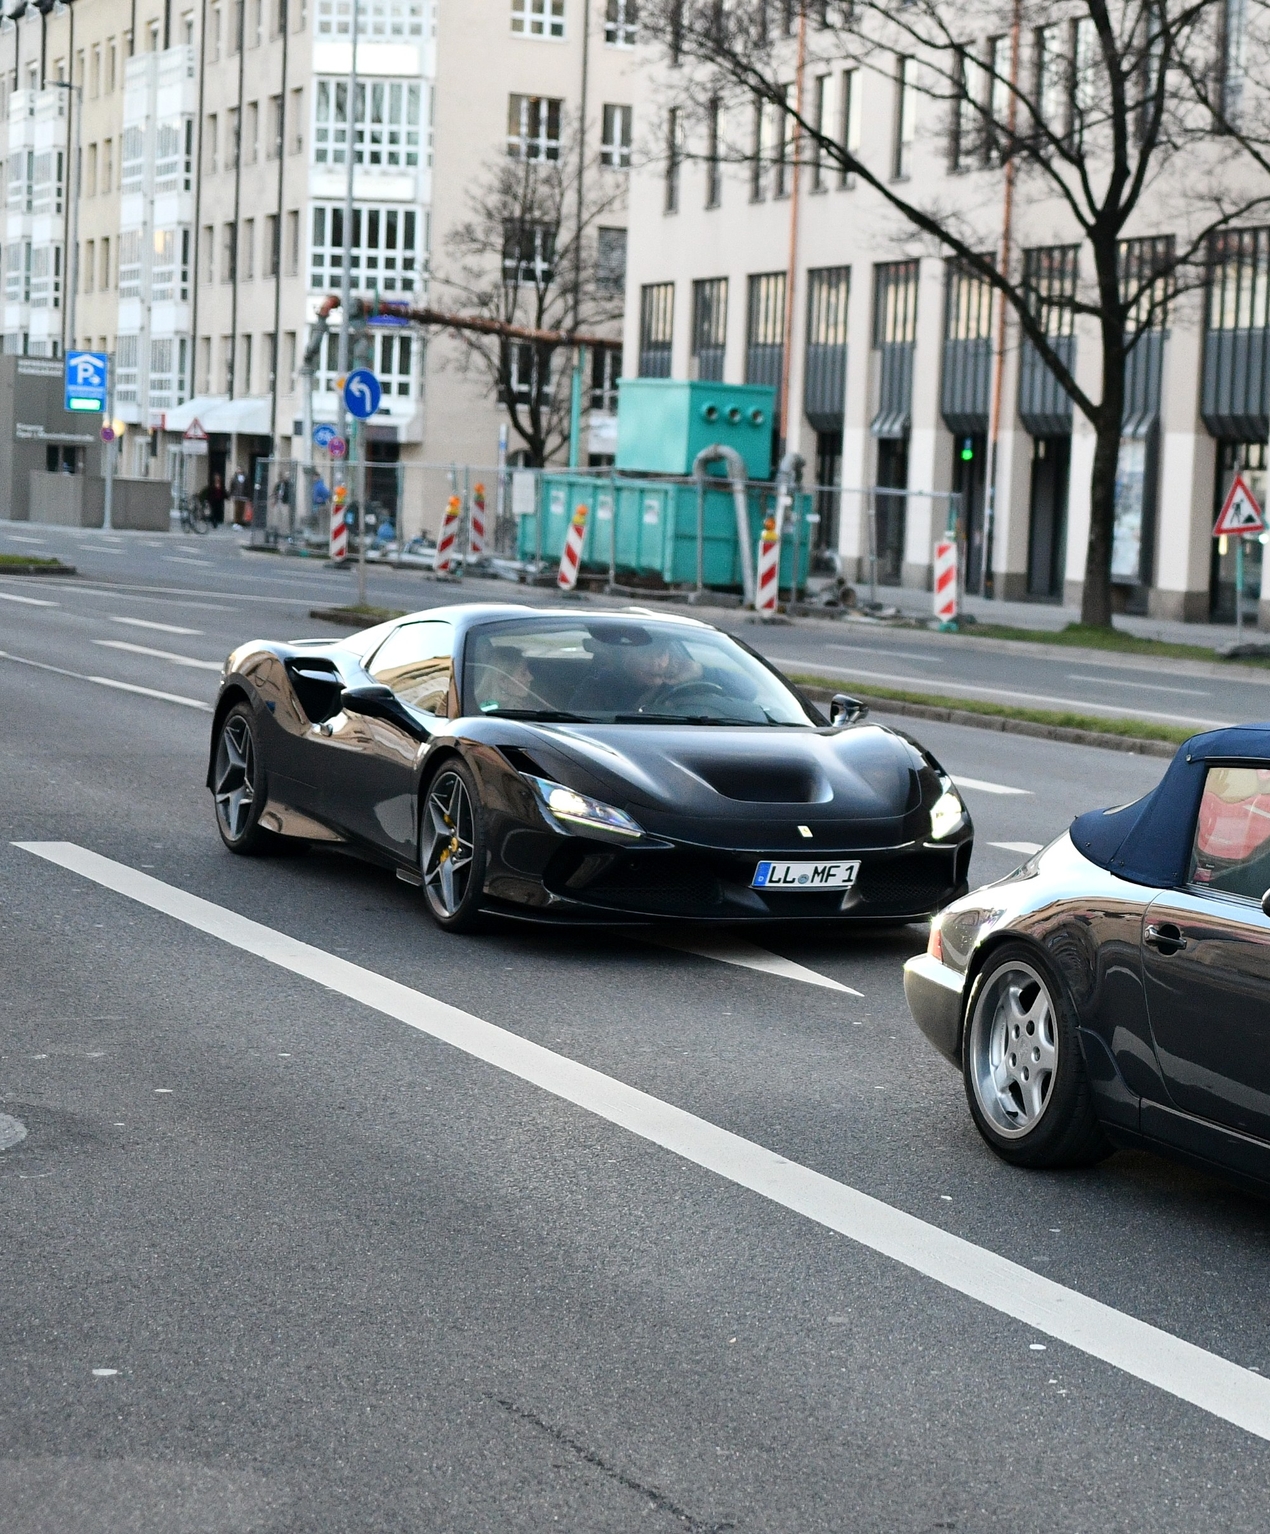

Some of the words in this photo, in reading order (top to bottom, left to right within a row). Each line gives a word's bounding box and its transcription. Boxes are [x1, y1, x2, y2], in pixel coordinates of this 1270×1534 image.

[768, 866, 796, 883] LL
[810, 865, 842, 883] MF
[841, 865, 855, 883] 1
